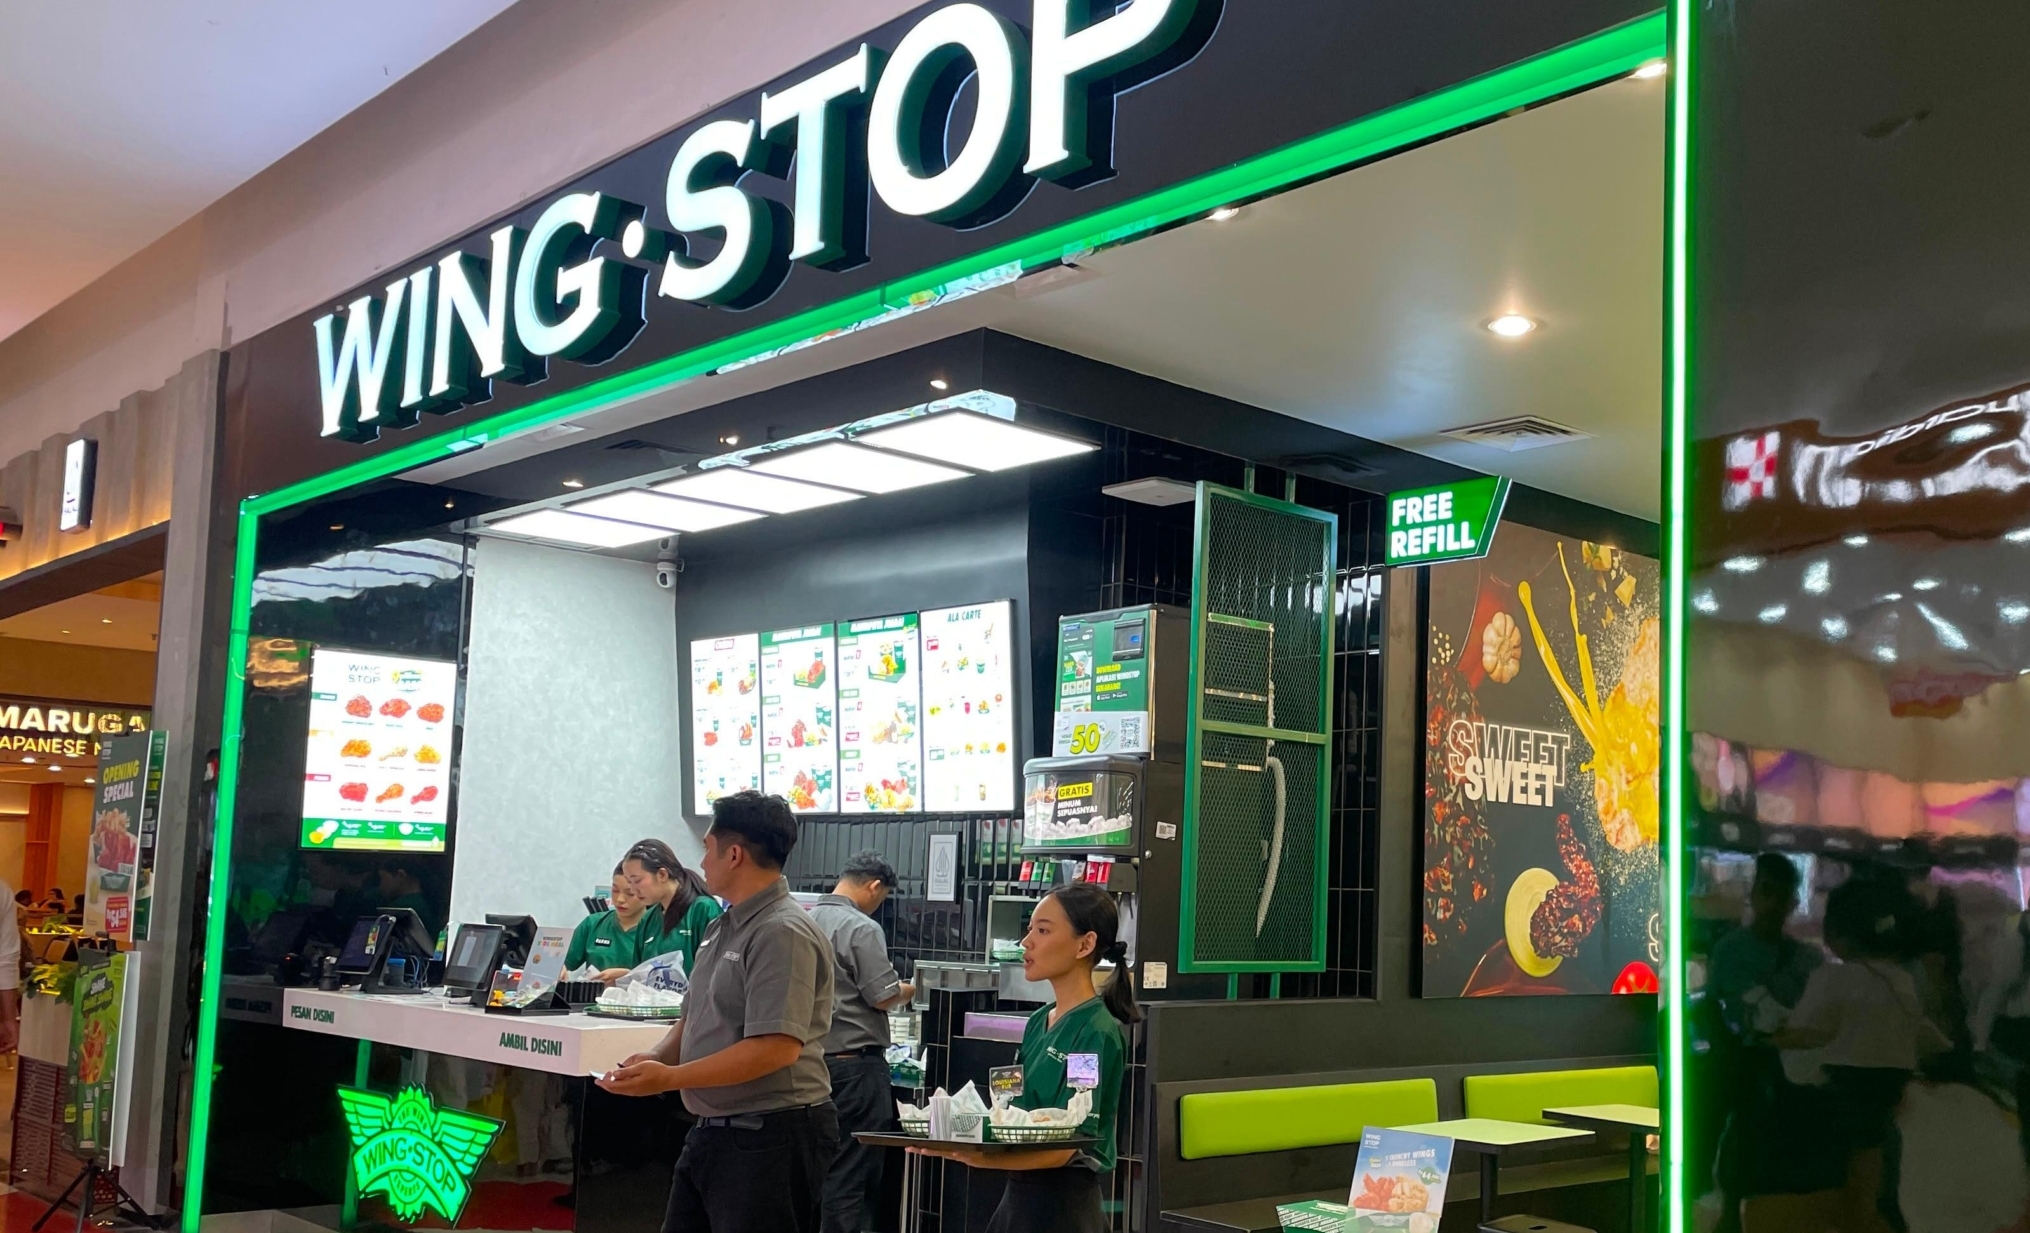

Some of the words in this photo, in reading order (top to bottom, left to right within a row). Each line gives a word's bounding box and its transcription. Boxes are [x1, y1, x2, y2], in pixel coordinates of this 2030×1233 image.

[1391, 491, 1453, 527] FREE
[1391, 521, 1476, 558] REFILL
[948, 612, 959, 622] ALA
[962, 609, 981, 620] CARTE
[349, 675, 380, 684] STOP
[1448, 719, 1570, 787] SWEET
[103, 760, 140, 784] OPENING
[1464, 756, 1557, 807] SWEET
[103, 781, 134, 803] SPECIAL
[1060, 785, 1090, 797] GRATIS
[1057, 805, 1098, 817] SIPUASNYA!
[1058, 799, 1081, 809] MINUM
[291, 1005, 312, 1020] PESAN
[313, 1008, 335, 1024] DISINI
[499, 1032, 528, 1051] AMBIL
[531, 1037, 562, 1056] DISINI
[993, 1078, 1020, 1086] LOUISIANA
[398, 1108, 412, 1124] THE
[1412, 1149, 1436, 1158] WINGS
[393, 1173, 421, 1197] EXPERTS
